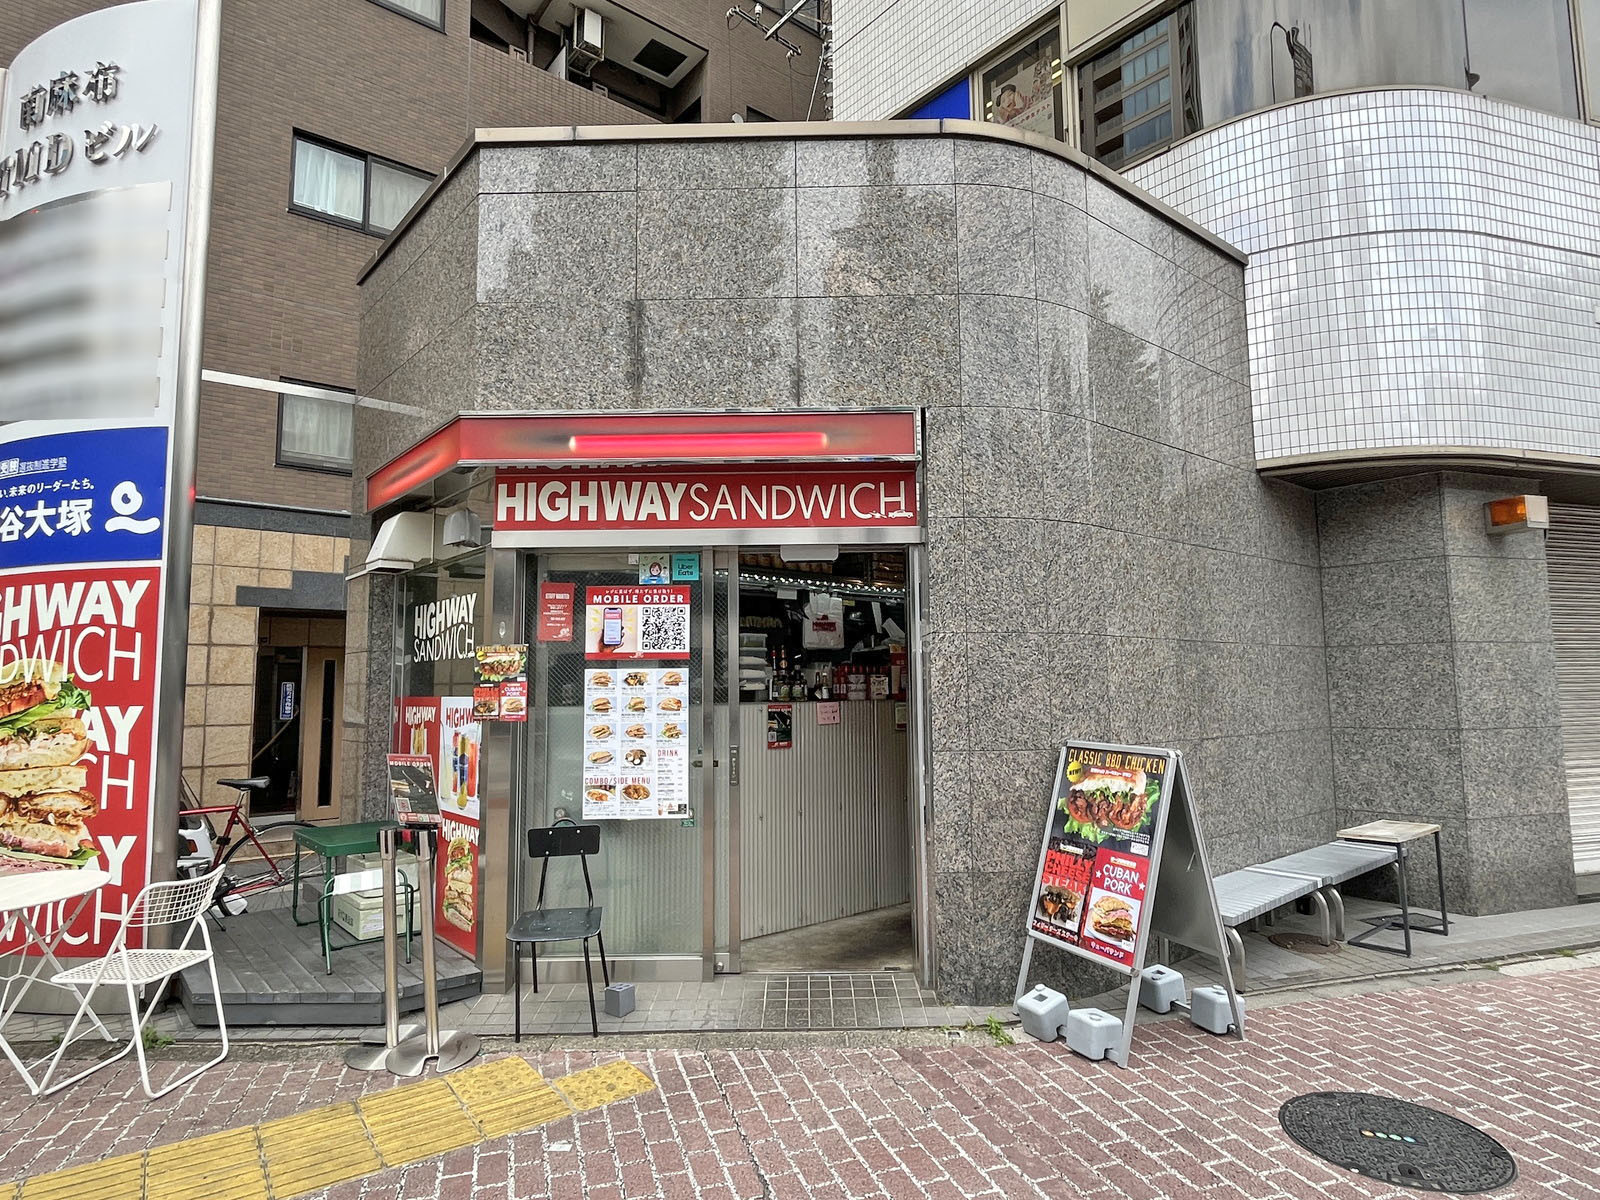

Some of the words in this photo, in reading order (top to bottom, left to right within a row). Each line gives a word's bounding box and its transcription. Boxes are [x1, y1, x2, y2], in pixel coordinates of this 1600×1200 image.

[20, 61, 120, 131] 南麻布
[497, 482, 688, 521] HIGHWAY
[689, 479, 906, 521] SANDWICH
[0, 499, 93, 542] 谷大塚
[0, 580, 150, 643] HWAY
[593, 594, 638, 604] MOBILE
[643, 594, 684, 604] ORDER
[414, 592, 477, 640] HIGHWAY
[413, 624, 475, 663] SANDWICH
[405, 705, 437, 726] HIGHWAY
[658, 749, 678, 757] DRINK
[1068, 748, 1103, 767] CLASSIC
[1105, 752, 1122, 769] BBQ
[1125, 755, 1166, 775] CHICKEN
[442, 818, 480, 847] HIGHWAY
[1102, 864, 1140, 884] CUBAN
[1103, 878, 1132, 895] PORK
